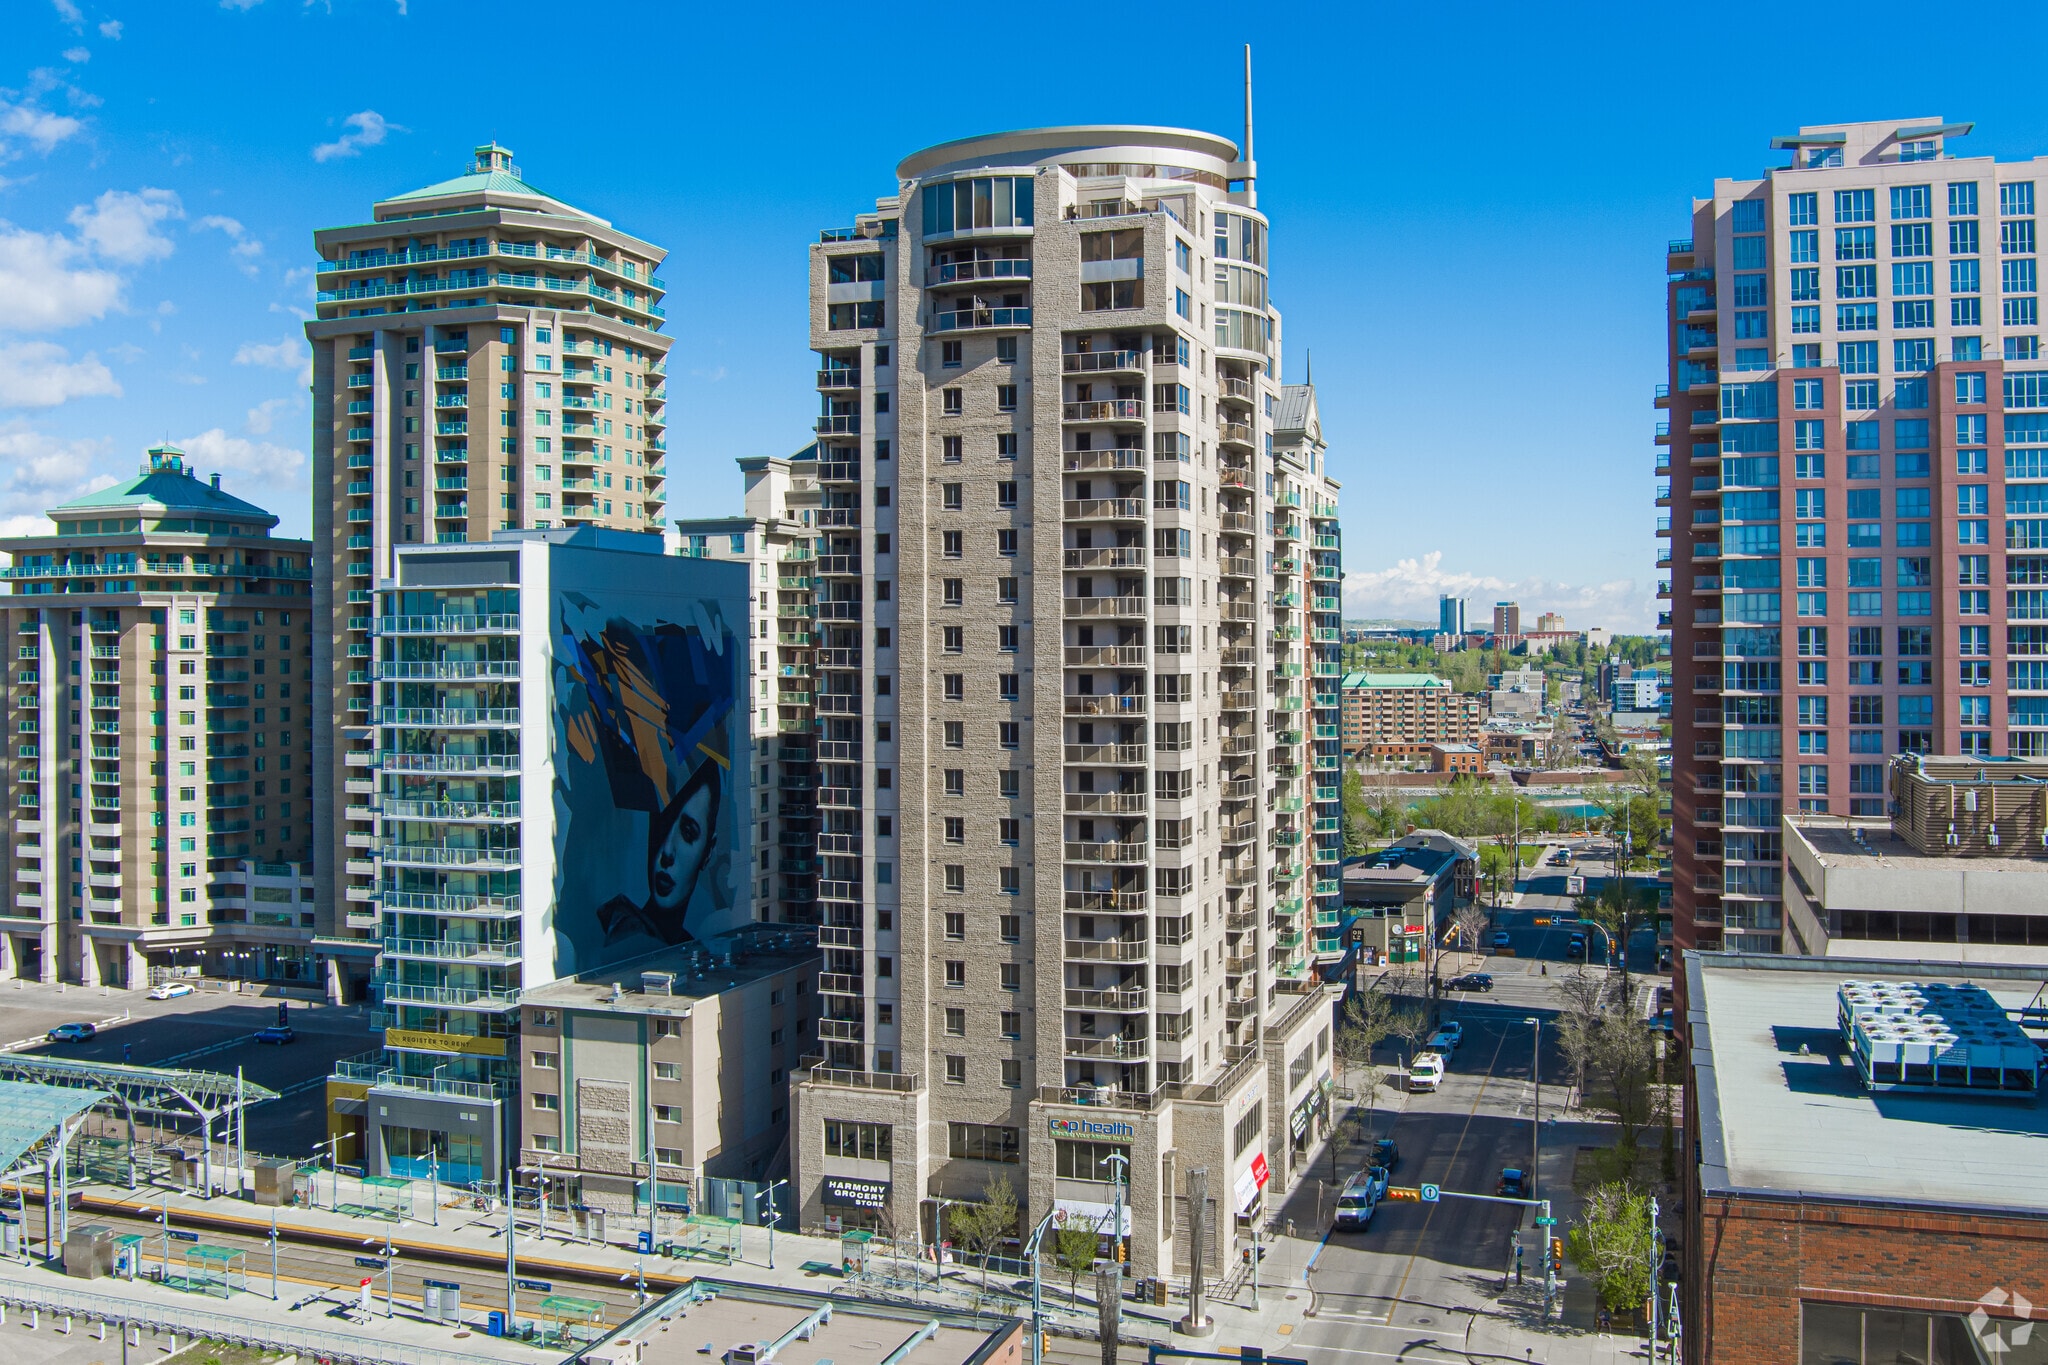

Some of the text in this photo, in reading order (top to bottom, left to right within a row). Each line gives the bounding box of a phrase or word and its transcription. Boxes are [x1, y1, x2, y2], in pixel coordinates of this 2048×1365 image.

[402, 1035, 437, 1045] REGISTER
[1082, 1119, 1135, 1136] health
[828, 1180, 886, 1194] HARMONY
[834, 1189, 885, 1201] GROCERY
[855, 1199, 884, 1208] STORE
